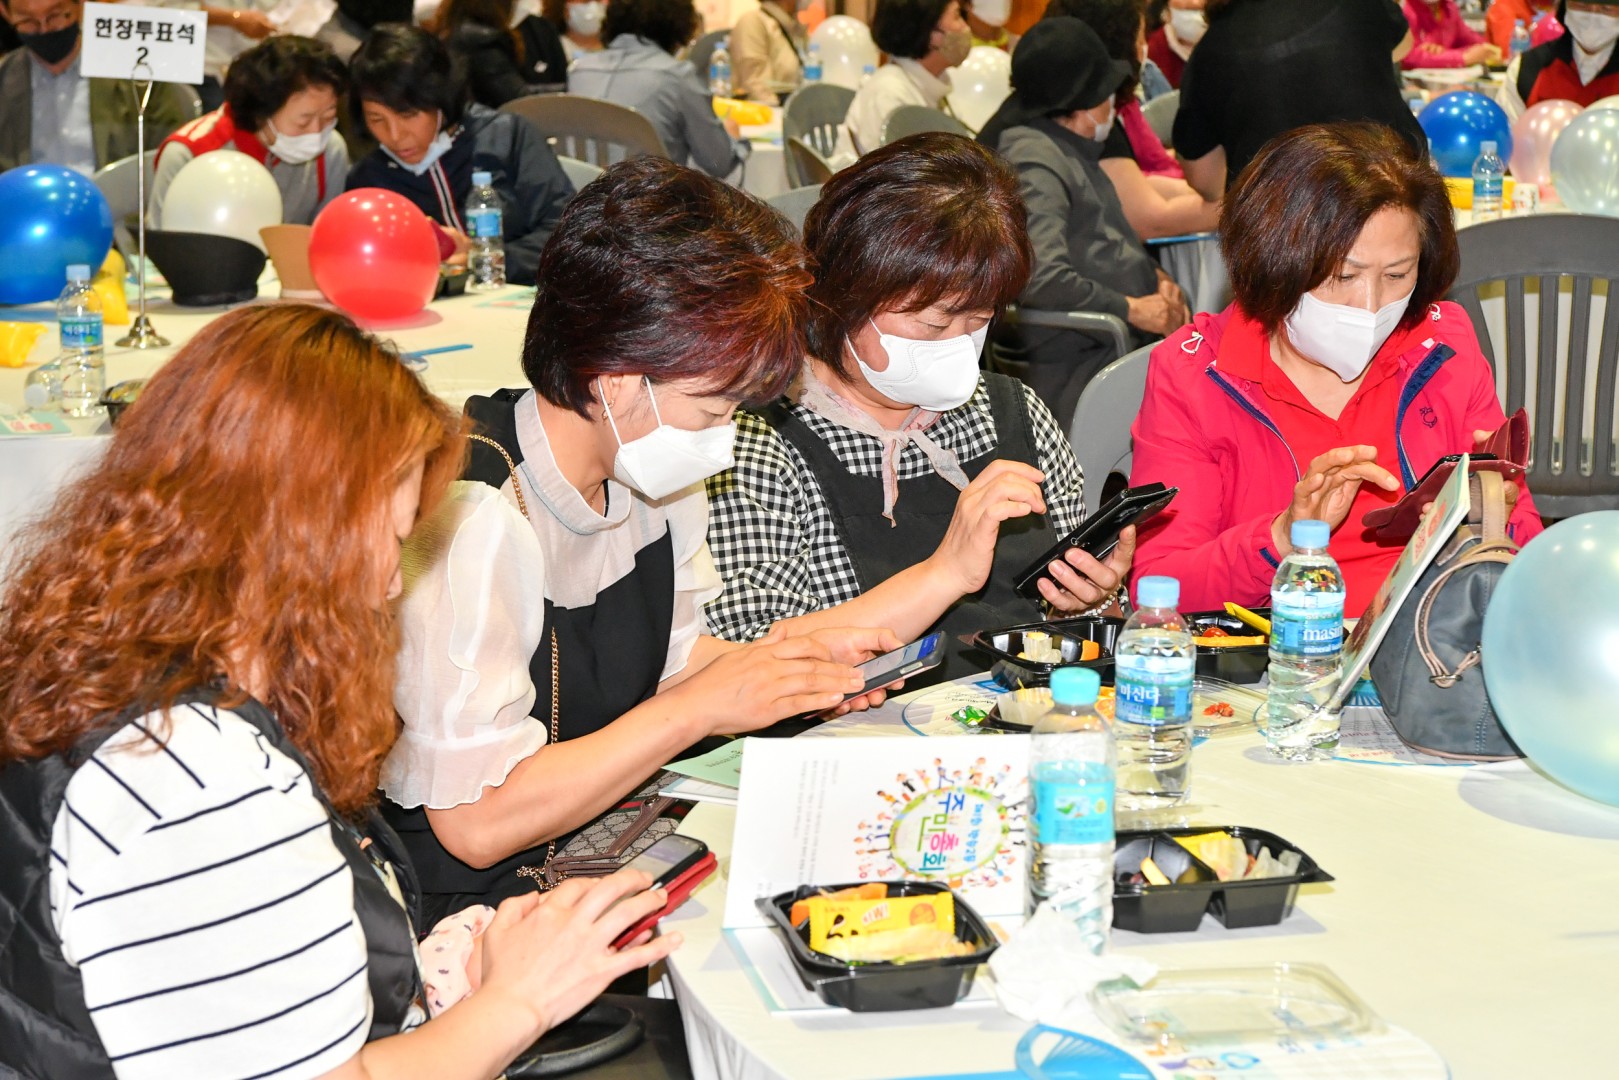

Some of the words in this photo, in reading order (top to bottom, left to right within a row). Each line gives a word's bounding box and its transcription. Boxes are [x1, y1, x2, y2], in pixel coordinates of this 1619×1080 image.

[95, 18, 195, 45] 현장투표석
[137, 46, 149, 66] 2
[917, 793, 965, 871] 주민총회
